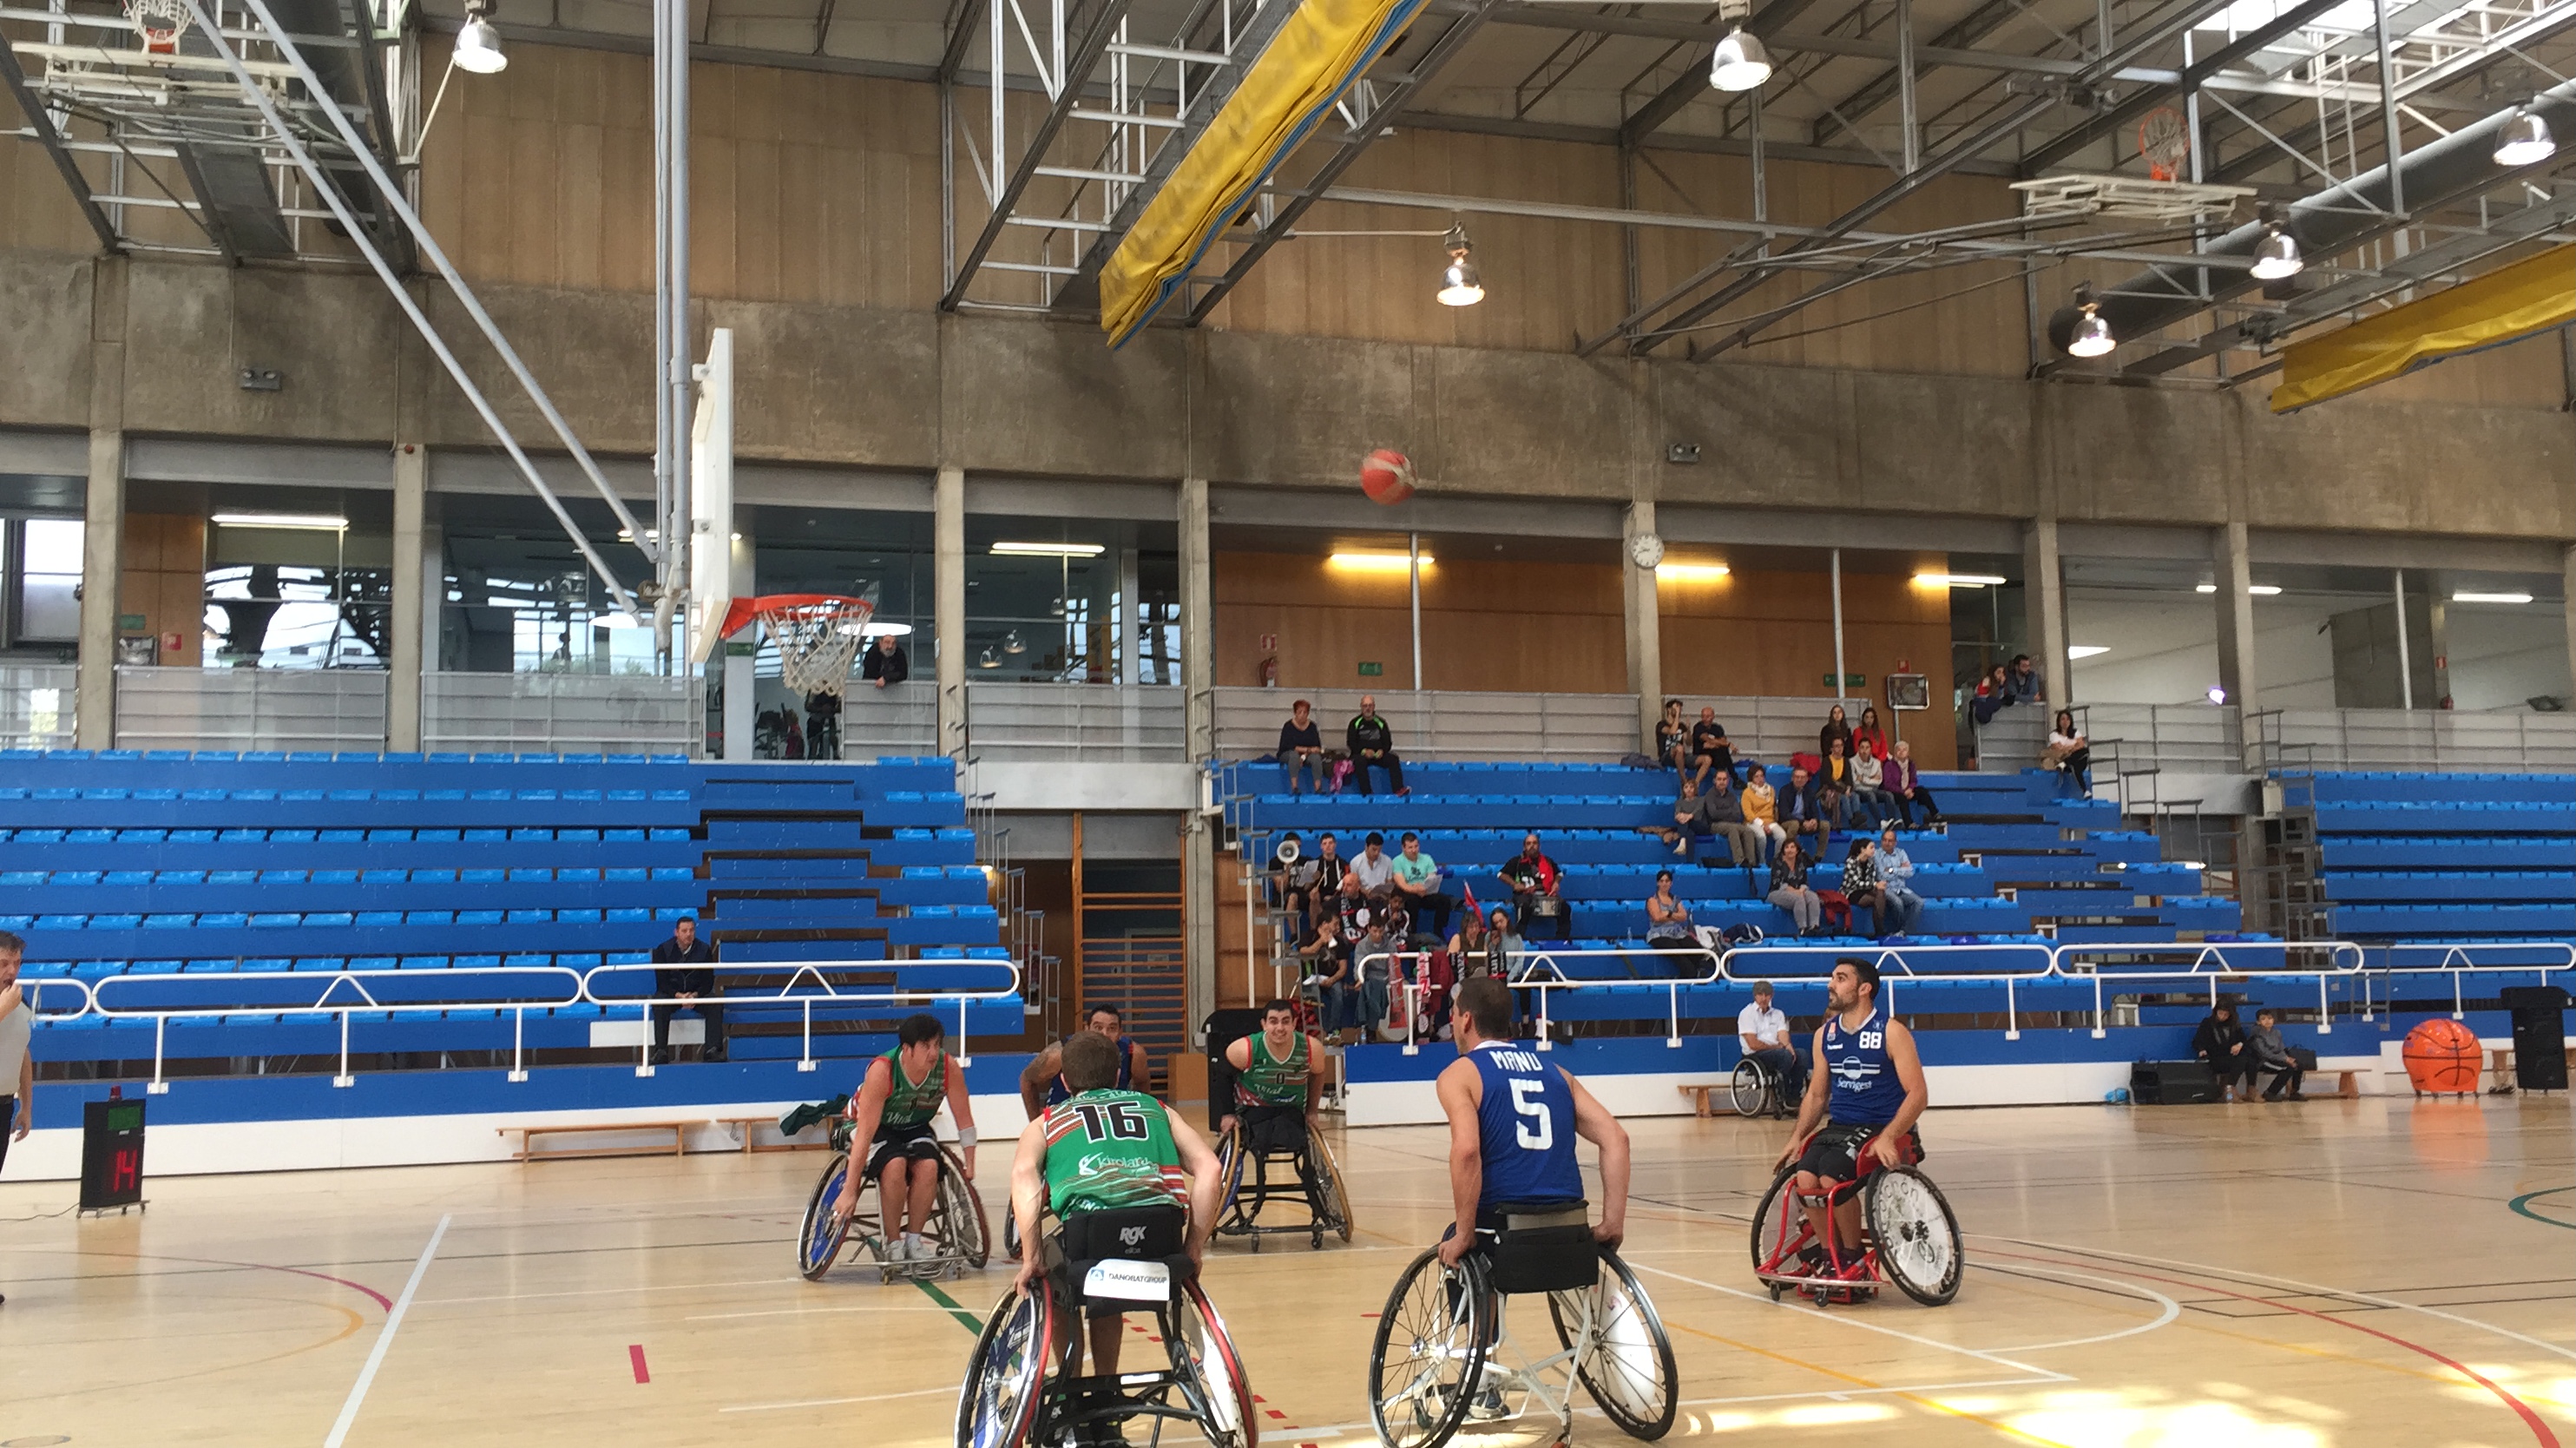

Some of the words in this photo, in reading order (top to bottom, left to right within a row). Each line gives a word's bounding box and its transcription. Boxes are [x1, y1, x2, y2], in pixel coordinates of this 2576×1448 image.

[1859, 1031, 1883, 1050] 88
[1488, 1050, 1543, 1072] MANU
[1074, 1101, 1149, 1143] 16
[1508, 1078, 1553, 1150] 5
[113, 1149, 138, 1193] 14
[1119, 1226, 1147, 1246] RGK
